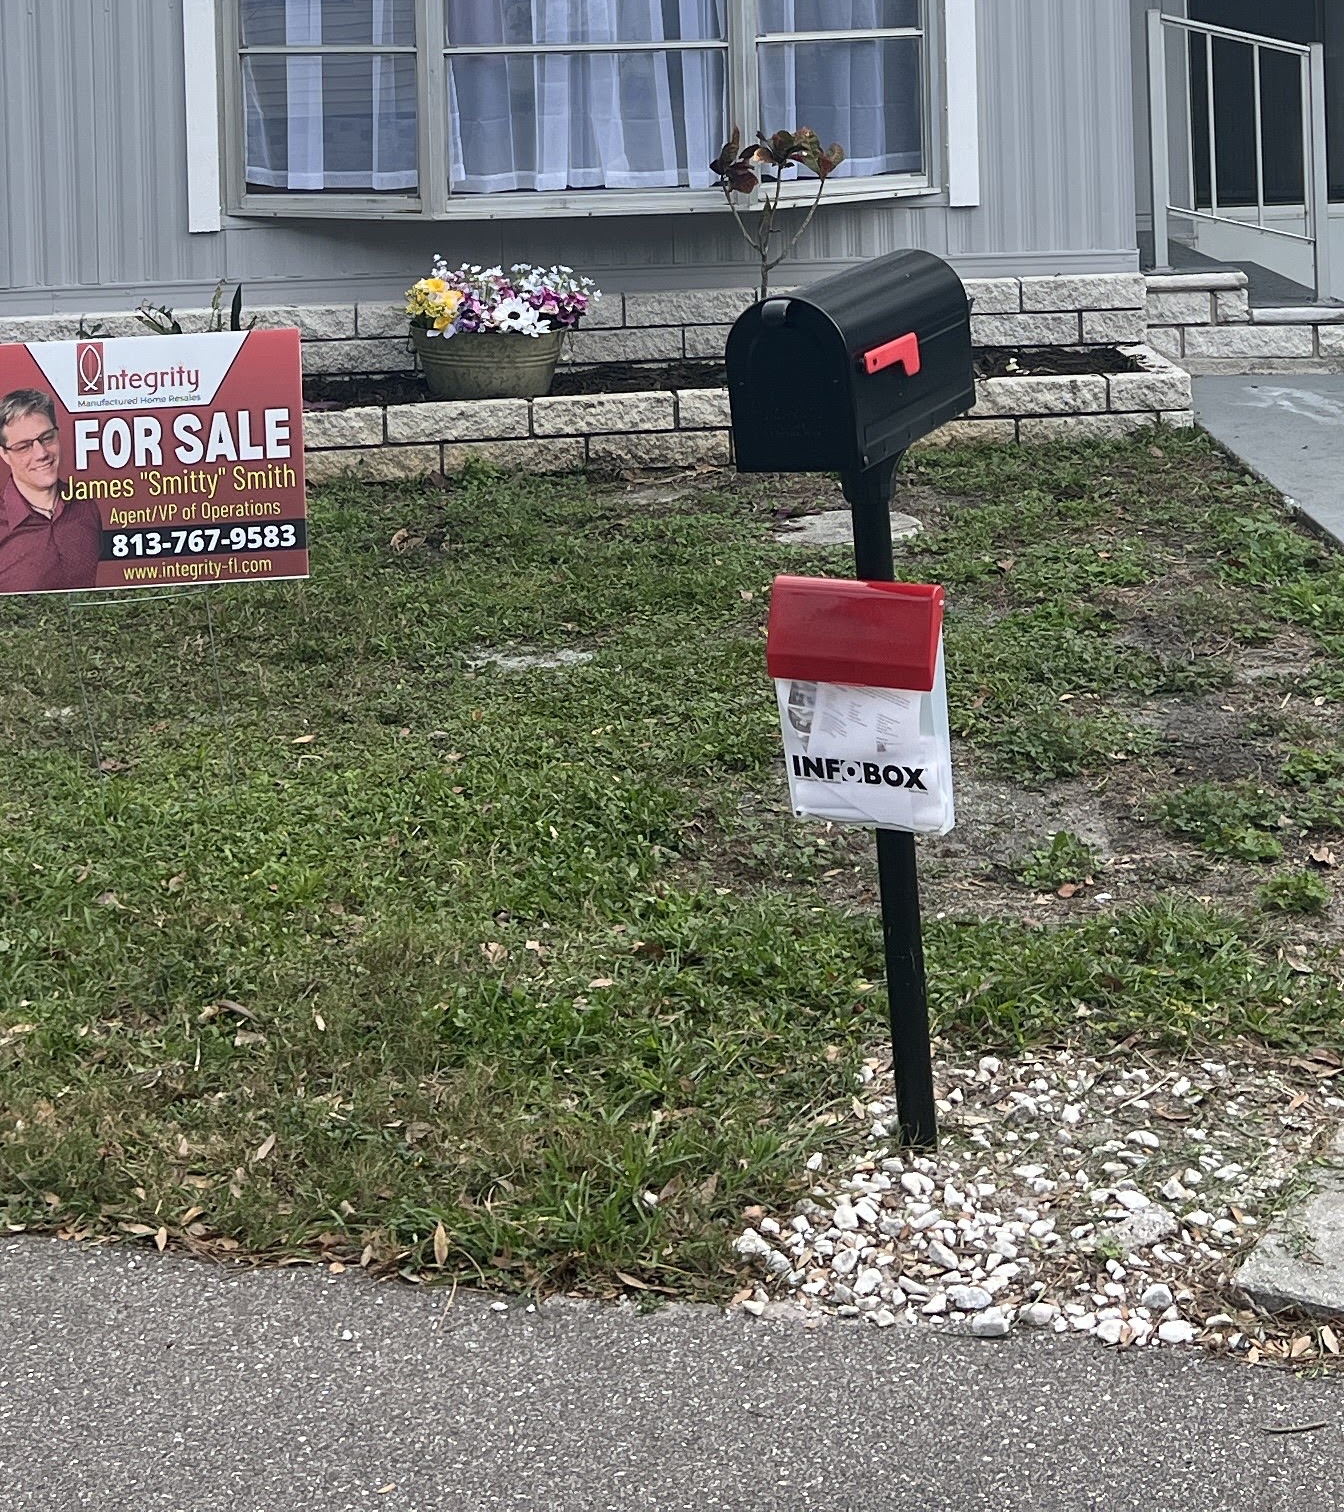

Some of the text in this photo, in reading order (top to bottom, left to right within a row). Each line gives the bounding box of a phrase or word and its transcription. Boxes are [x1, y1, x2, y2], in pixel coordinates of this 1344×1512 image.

[77, 393, 202, 408] Manufactured Home Resales
[74, 408, 291, 471] FOR SALE
[61, 463, 296, 501] James "Smitty" Smith
[109, 499, 281, 529] Agent/VP of Operations
[112, 524, 297, 557] 813-767-9583
[123, 557, 272, 581] www.integrity-fl.com
